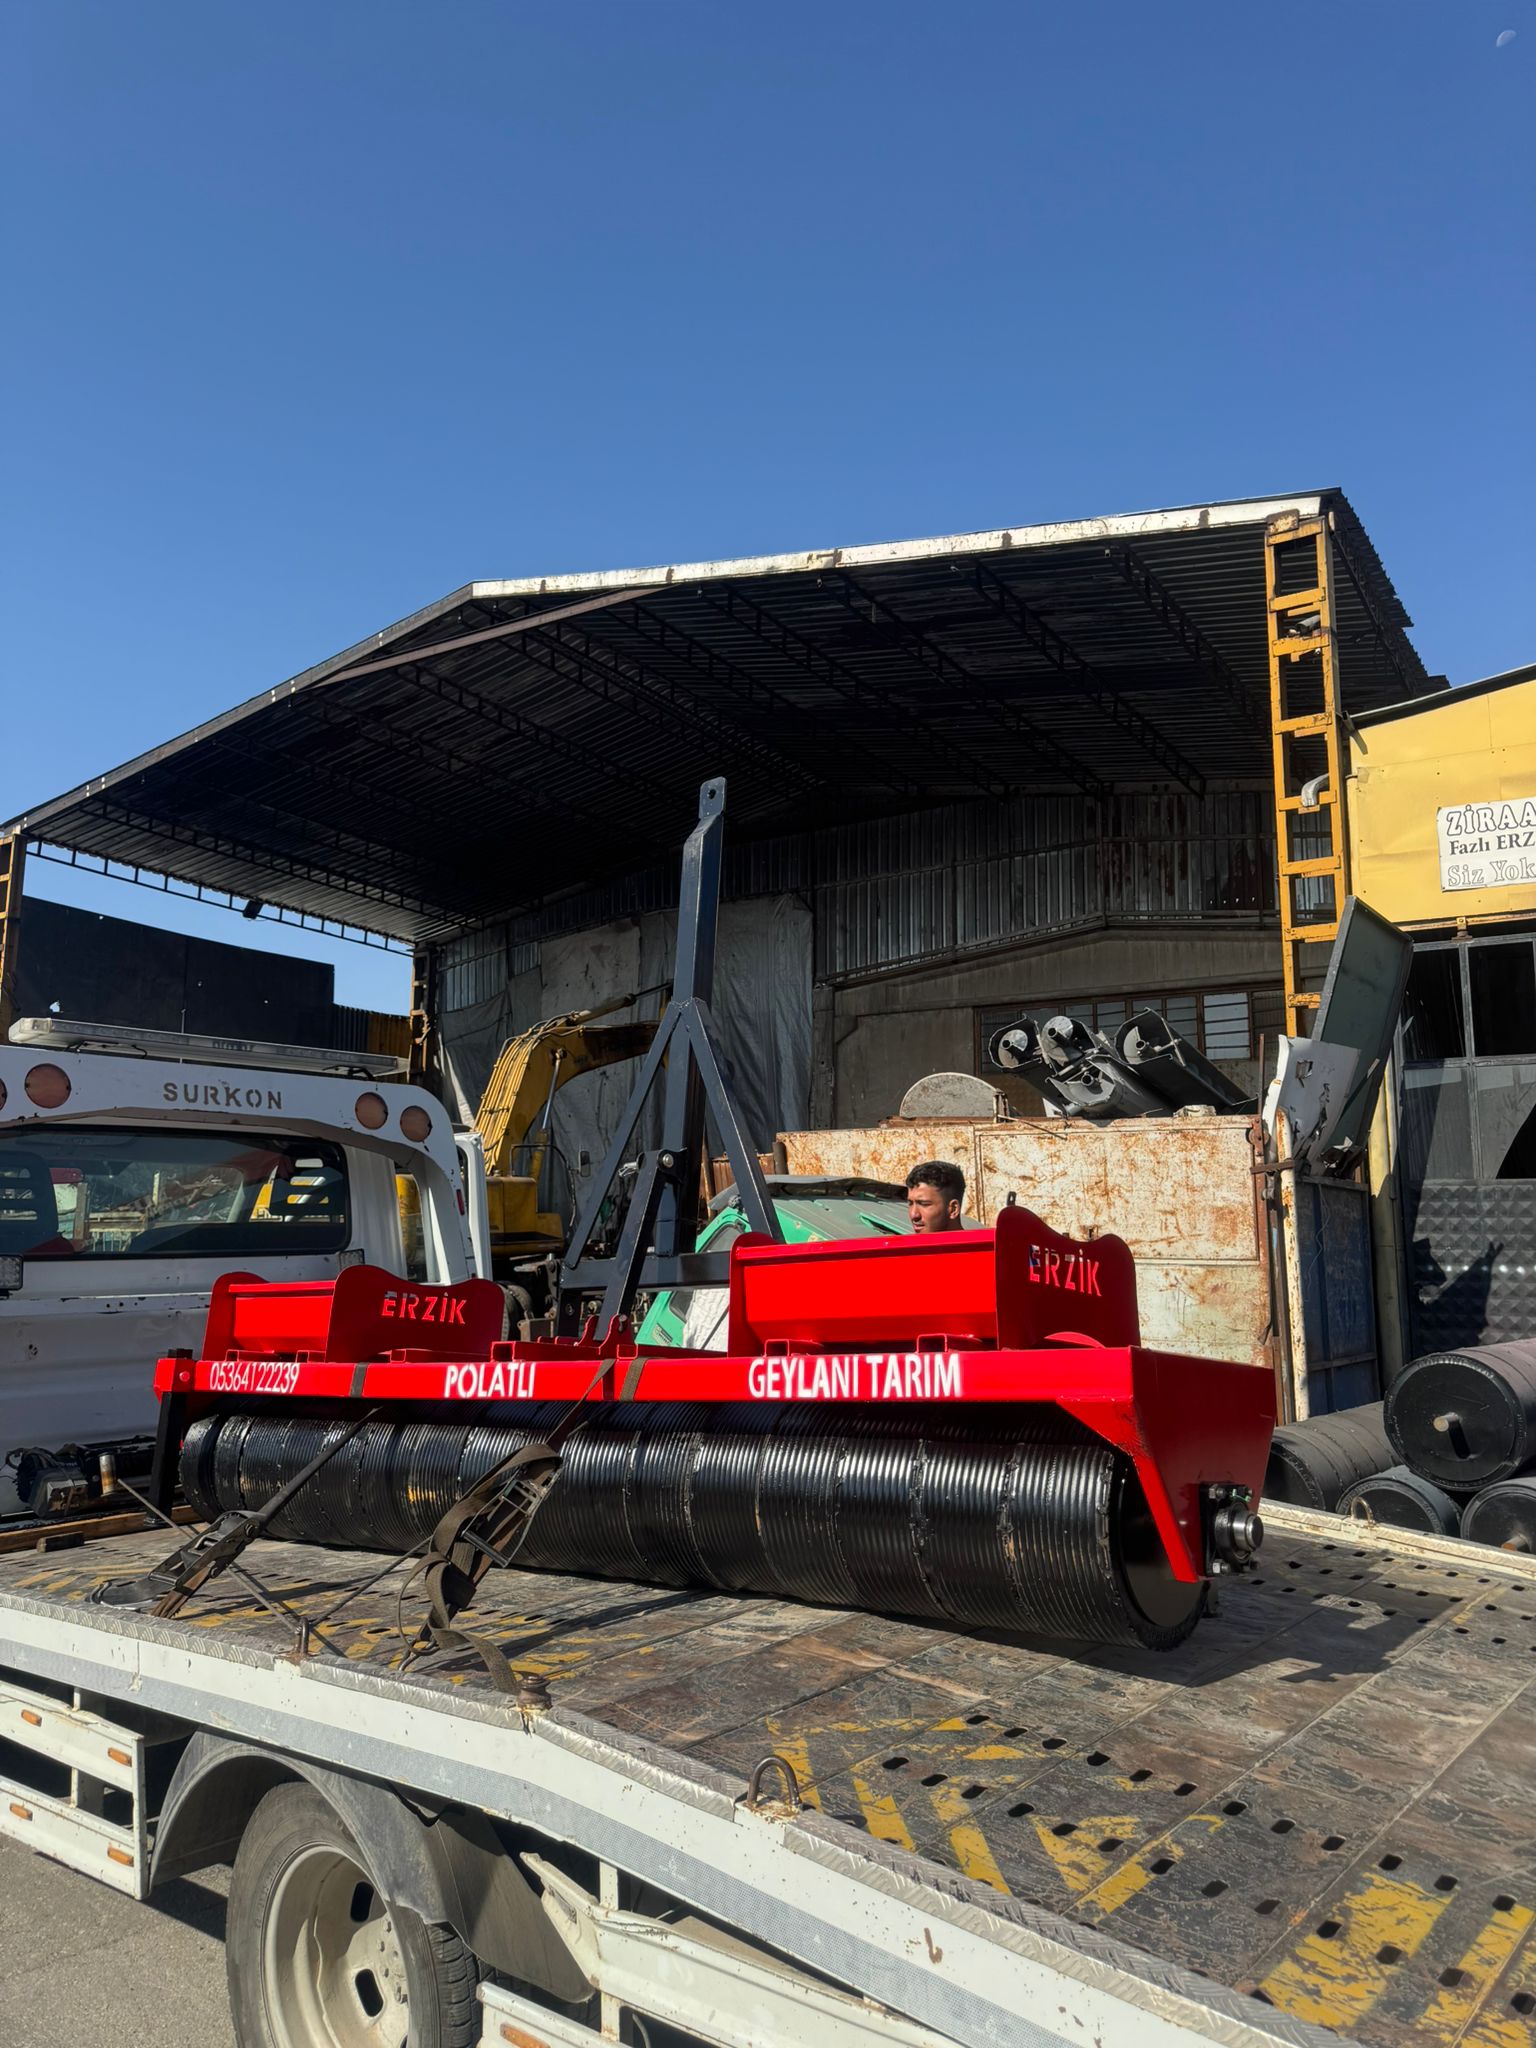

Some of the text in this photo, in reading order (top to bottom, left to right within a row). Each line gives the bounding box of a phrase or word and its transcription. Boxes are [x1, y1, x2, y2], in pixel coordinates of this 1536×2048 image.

[1446, 801, 1536, 836] ZİRAA
[1449, 831, 1536, 856] Fazlı ERZ
[1448, 857, 1536, 887] Siz Yok
[163, 1082, 282, 1110] SURKON
[1029, 1244, 1102, 1297] ERZİK
[381, 1291, 467, 1325] ERZİK
[209, 1362, 300, 1394] 05364122239
[444, 1362, 537, 1399] POLATLI
[748, 1353, 962, 1399] GEYLANI TARIM
